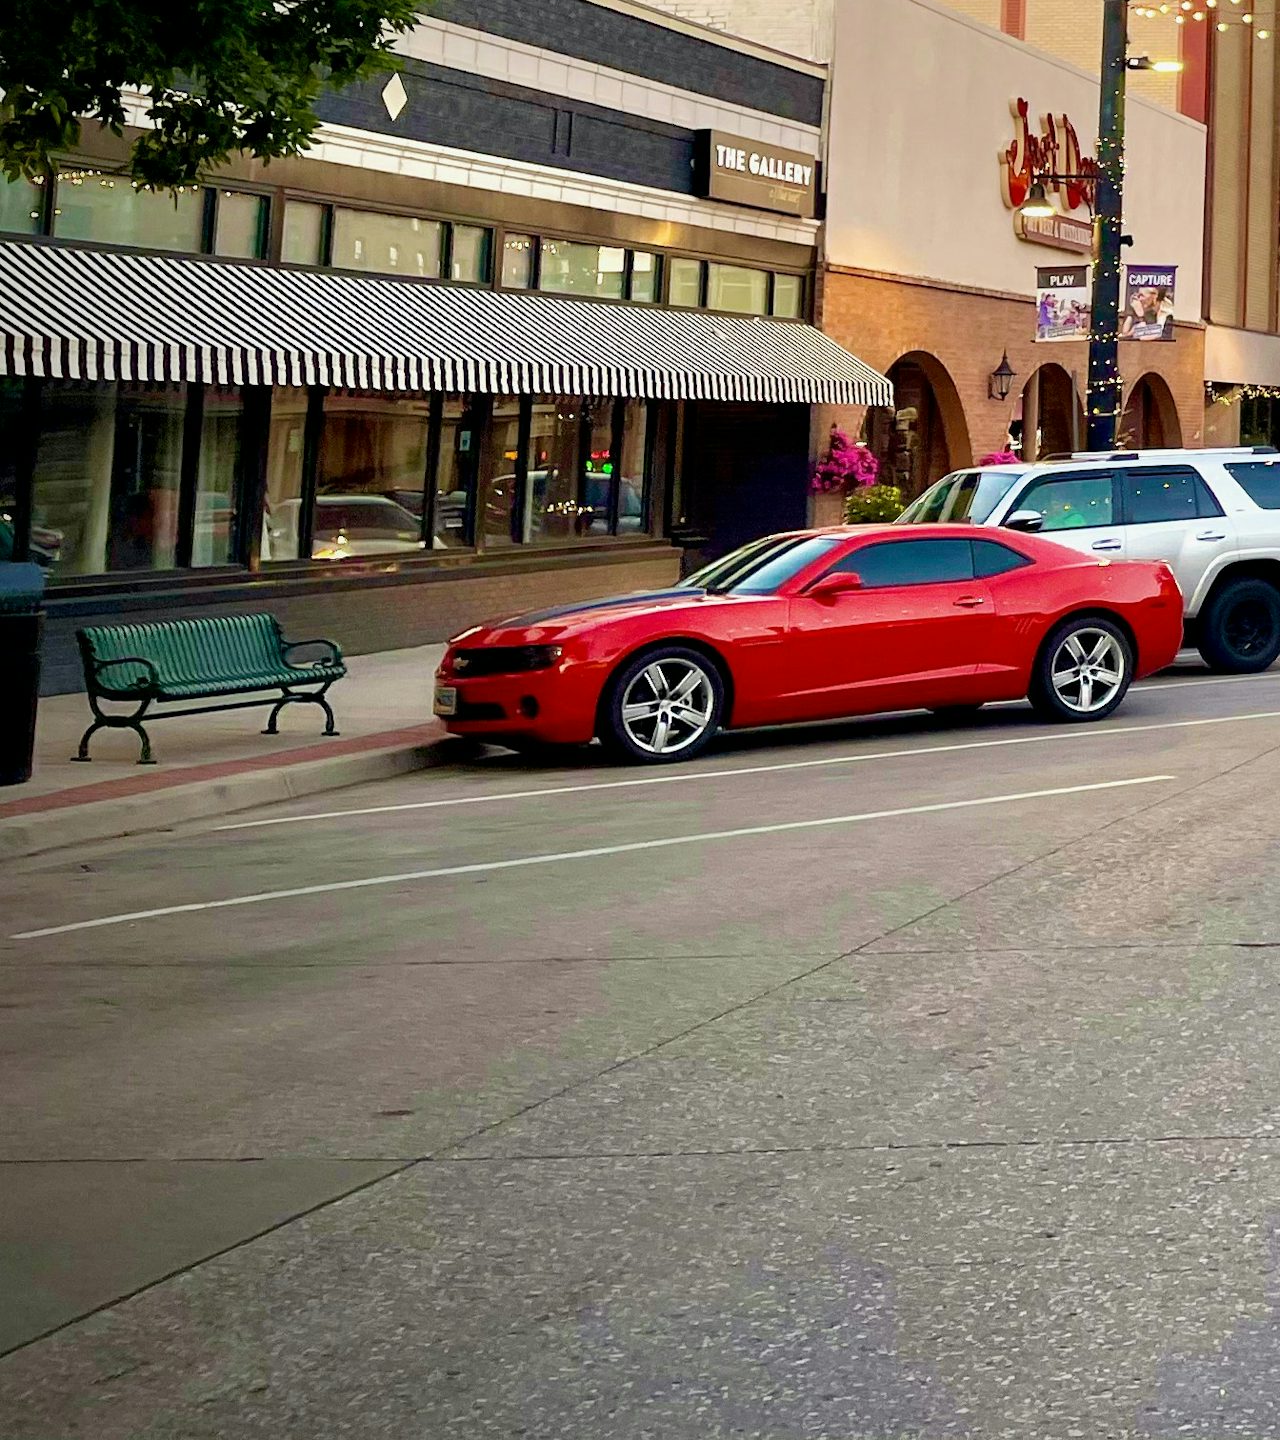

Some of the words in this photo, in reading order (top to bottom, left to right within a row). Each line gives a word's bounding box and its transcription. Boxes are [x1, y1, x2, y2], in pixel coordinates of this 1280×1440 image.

[716, 144, 747, 172] THE
[748, 152, 812, 186] GALLERY
[1049, 274, 1075, 286] PLAY
[1128, 273, 1173, 286] CAPTURE
